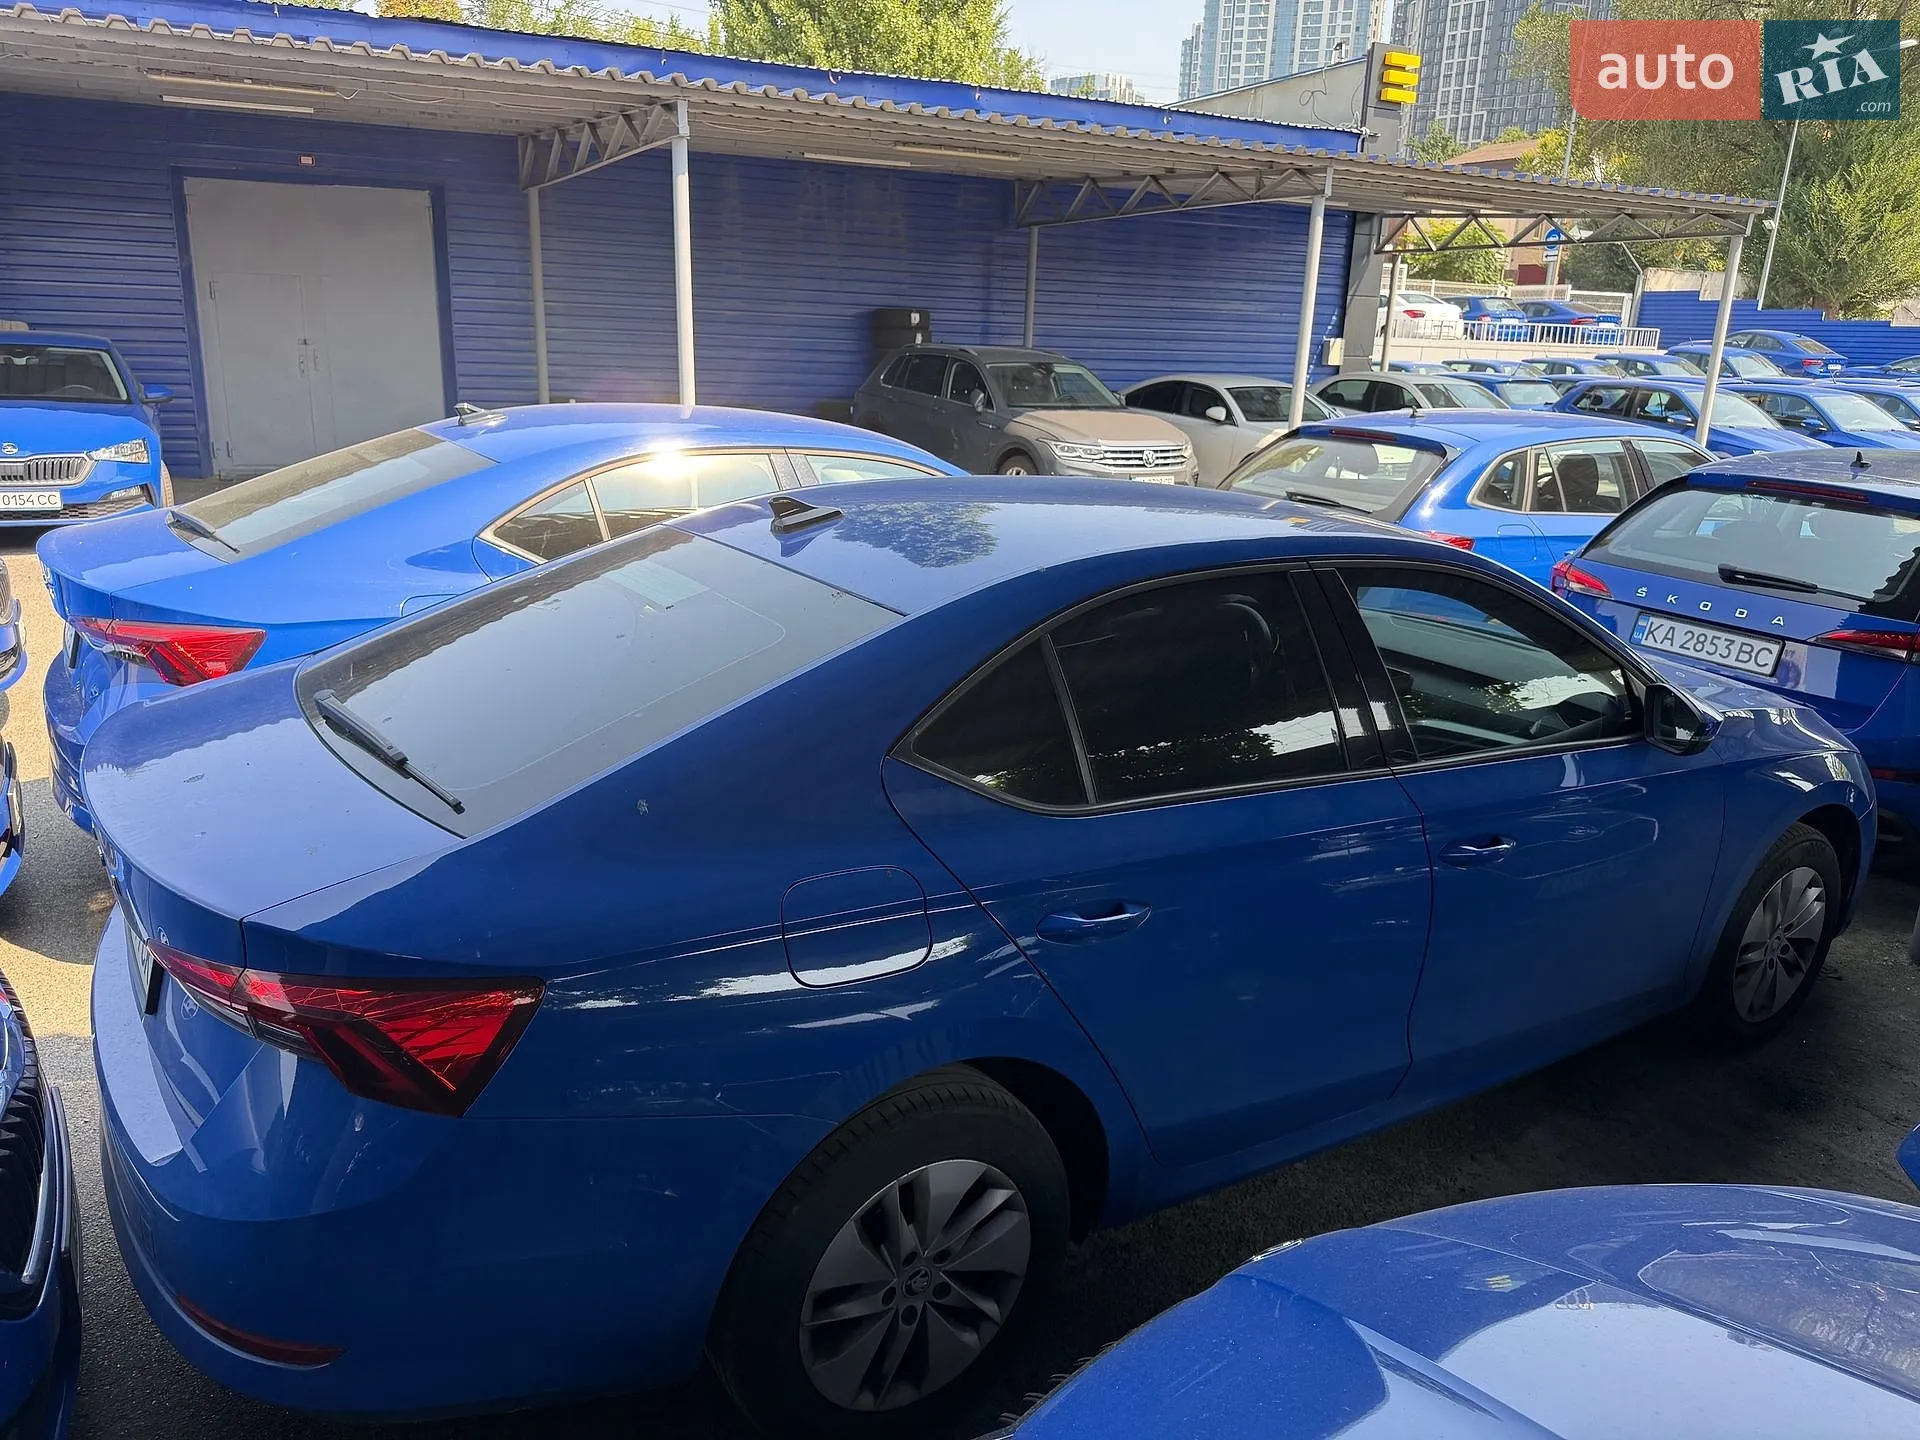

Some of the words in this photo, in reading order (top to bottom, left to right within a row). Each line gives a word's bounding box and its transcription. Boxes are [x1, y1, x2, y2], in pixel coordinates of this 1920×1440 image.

[2, 494, 35, 506] 0154
[37, 494, 58, 506] CC
[1644, 621, 1676, 647] KA
[1679, 630, 1735, 660] 2853
[1734, 641, 1774, 668] BC
